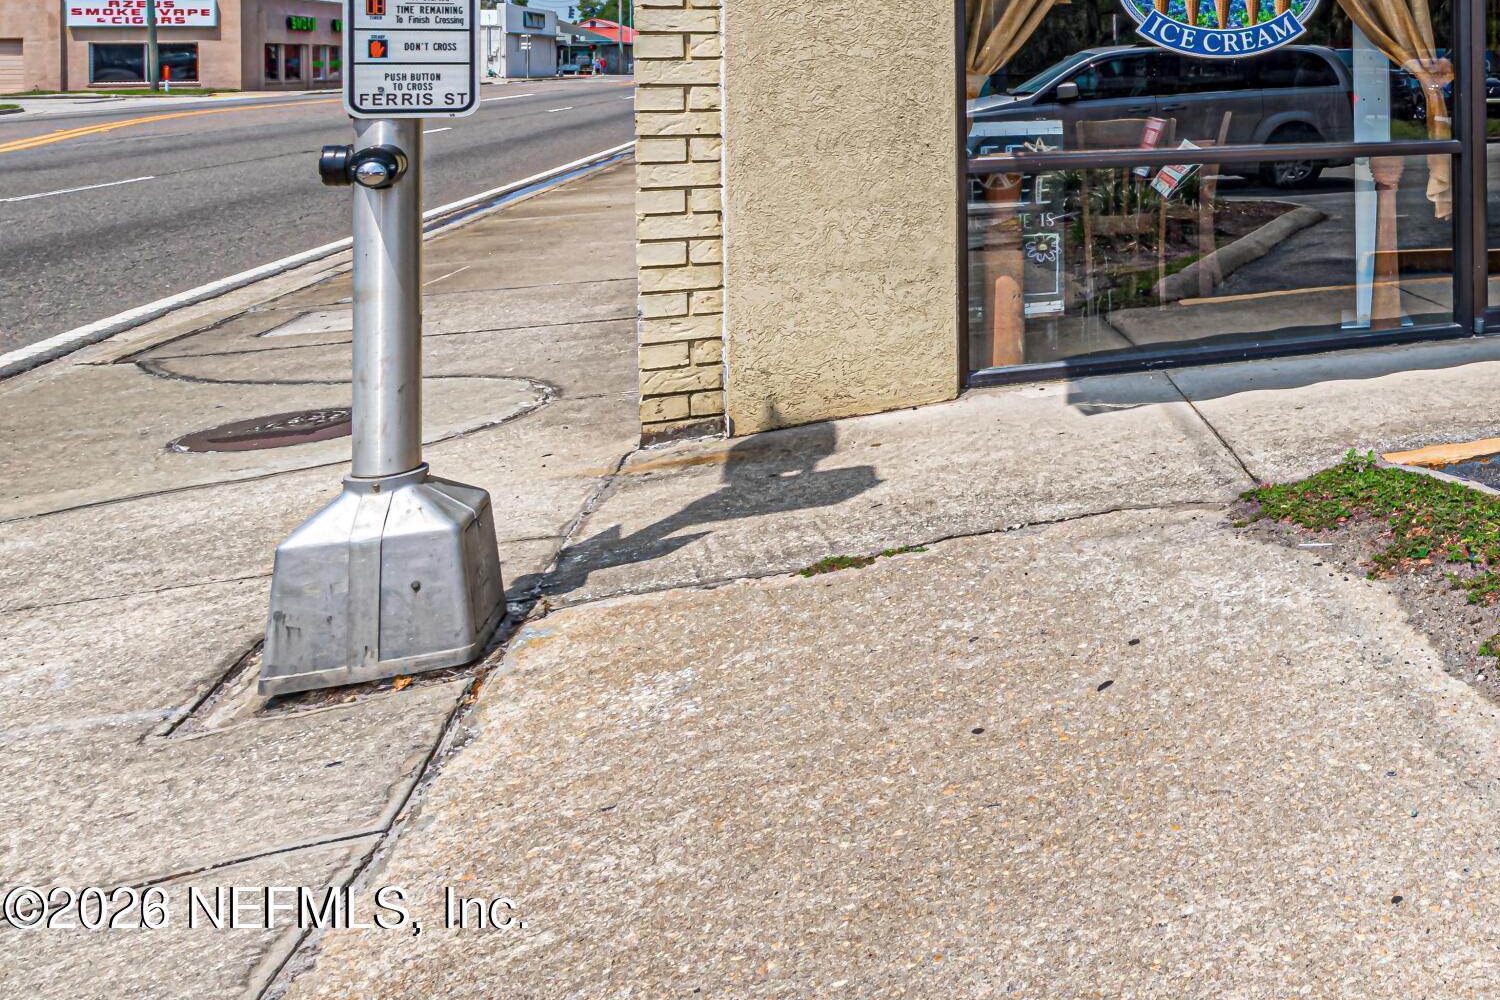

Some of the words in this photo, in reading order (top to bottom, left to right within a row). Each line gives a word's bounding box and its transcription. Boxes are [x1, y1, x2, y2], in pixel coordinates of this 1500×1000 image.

[71, 8, 141, 16] SMOKE
[397, 5, 414, 14] TIME
[420, 6, 463, 14] REMAINING
[396, 15, 403, 23] To
[408, 15, 430, 24] Finish
[435, 16, 464, 26] Crossing
[1148, 16, 1196, 49] ICE
[1203, 16, 1297, 52] CREAM
[404, 43, 428, 51] DON'T
[433, 43, 457, 51] CROSS
[384, 73, 407, 81] PUSH
[411, 73, 441, 81] BUTTON
[393, 83, 403, 91] TO
[407, 83, 433, 91] CROSS
[360, 93, 433, 106] FERRIS
[444, 92, 468, 105] ST
